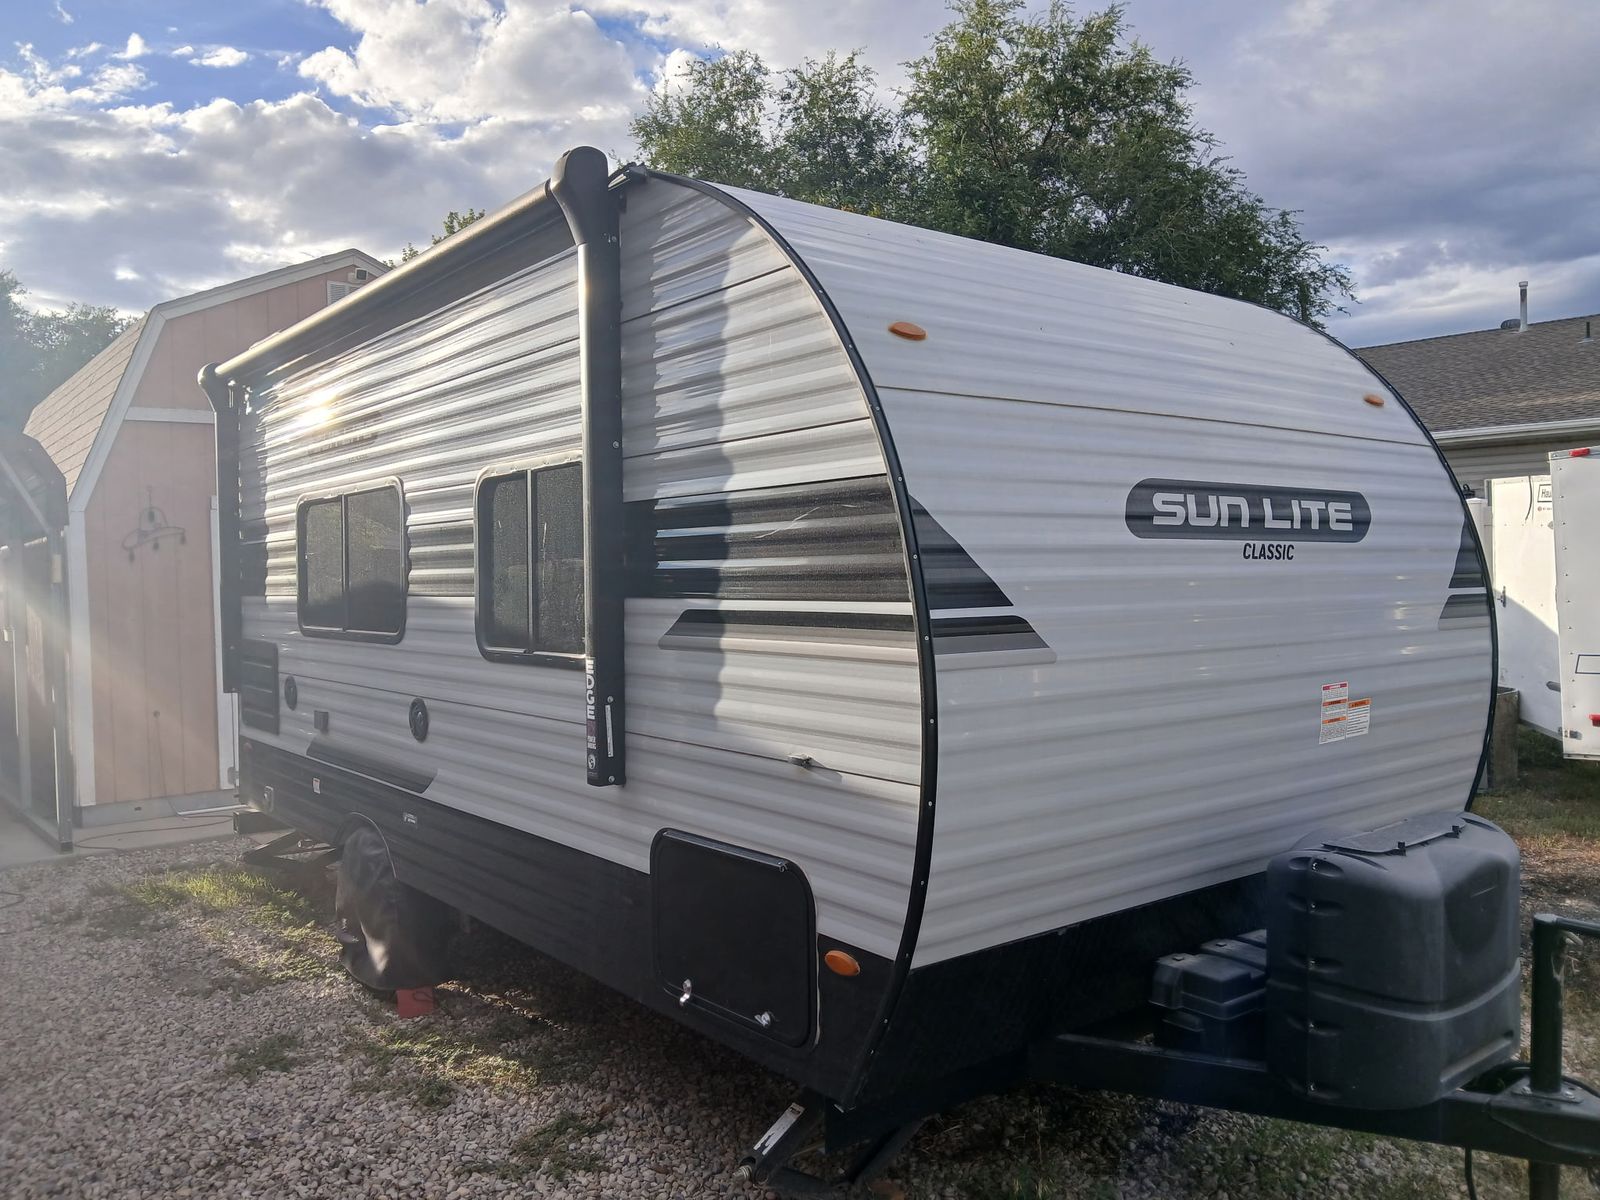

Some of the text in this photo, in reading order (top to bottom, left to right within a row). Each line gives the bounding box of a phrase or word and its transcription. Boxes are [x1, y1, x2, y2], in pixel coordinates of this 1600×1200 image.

[1152, 492, 1353, 531] SUN LITE
[1242, 543, 1294, 560] CLASSIC
[586, 659, 596, 720] EDGE
